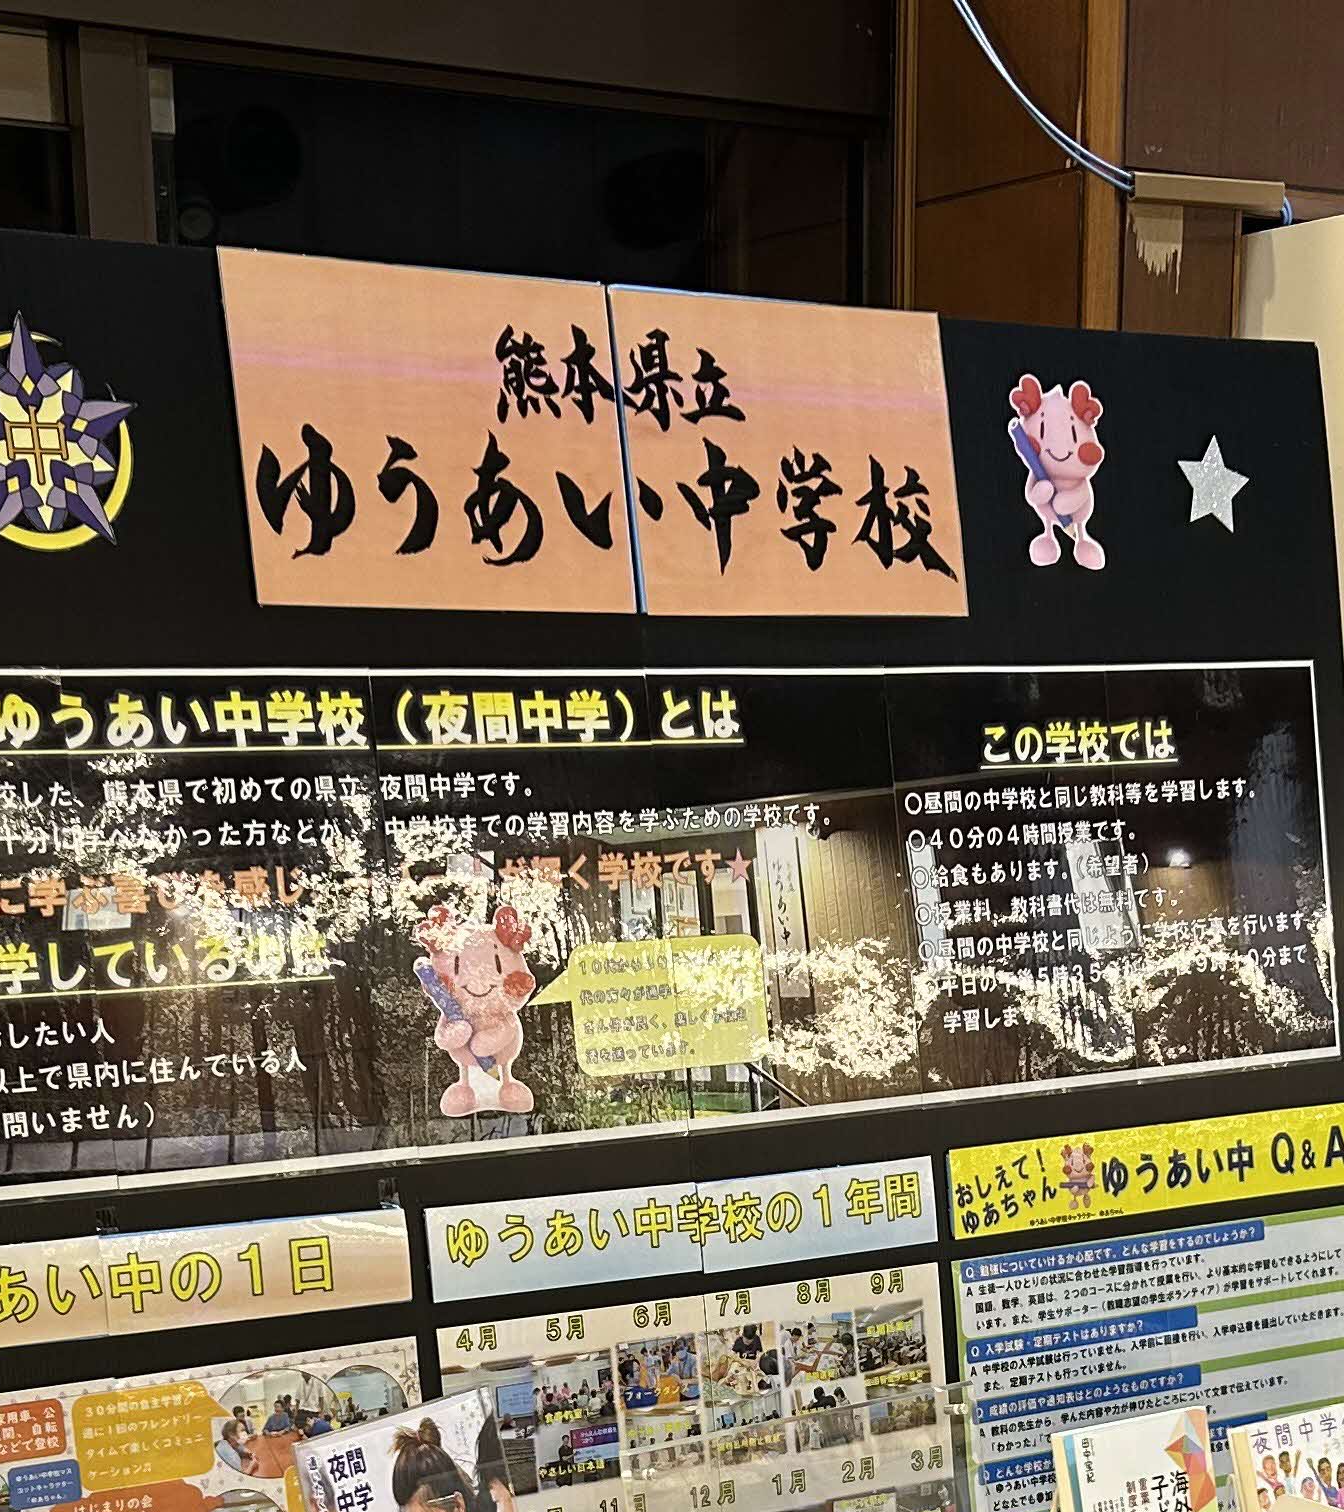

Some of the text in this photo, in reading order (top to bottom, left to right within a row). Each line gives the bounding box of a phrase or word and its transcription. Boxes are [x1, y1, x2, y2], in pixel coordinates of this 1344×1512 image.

[494, 322, 748, 433] 熊本県立
[254, 422, 961, 583] ゆうあい中学校
[981, 719, 1176, 764] この学校では
[955, 1149, 1047, 1212] おしえて!
[1101, 1138, 1255, 1197] ゆうあい中
[446, 1171, 923, 1269] ゆうあい中学校の1年間
[961, 1183, 1058, 1235] ゆあちゃん
[715, 1289, 752, 1318] 7月
[796, 1278, 832, 1305] 8月
[869, 1267, 905, 1296] 9月
[545, 1313, 585, 1342] 5月
[632, 1301, 673, 1329] 6月
[455, 1324, 498, 1353] 4月
